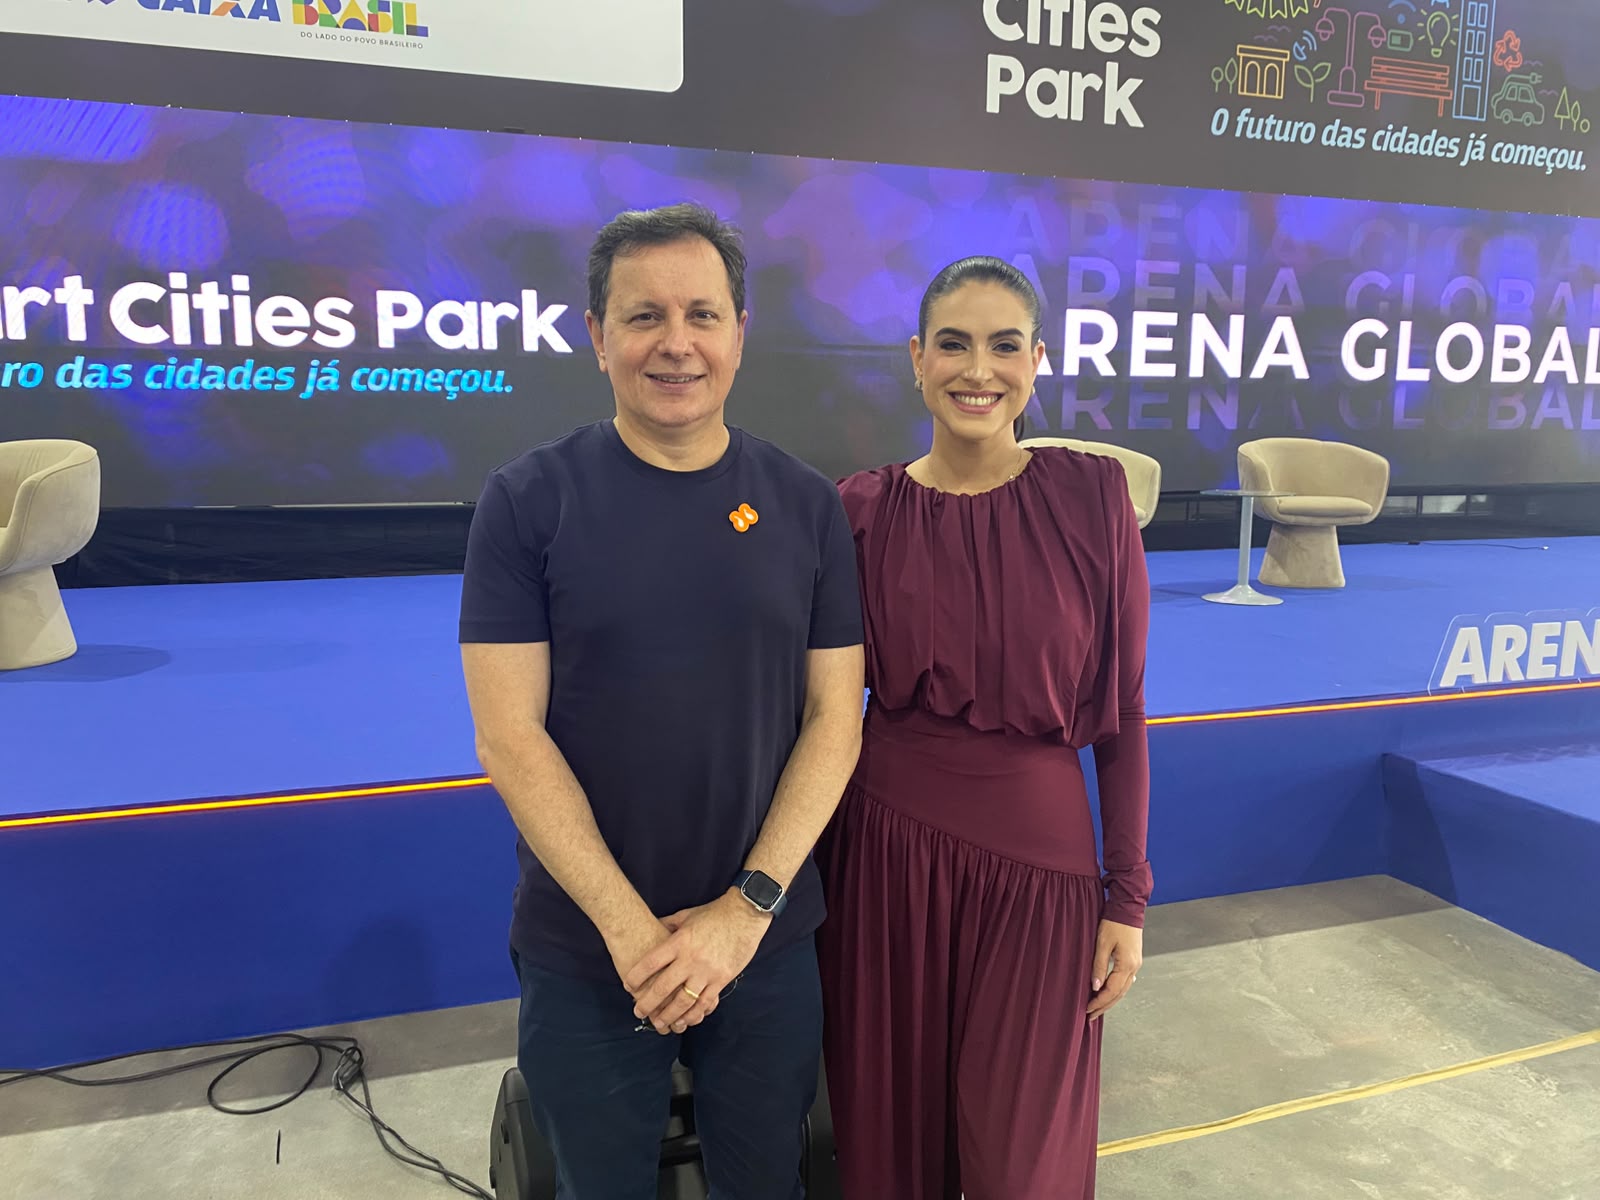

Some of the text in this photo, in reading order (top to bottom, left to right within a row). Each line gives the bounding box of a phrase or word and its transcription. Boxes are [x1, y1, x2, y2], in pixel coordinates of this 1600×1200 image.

[292, 0, 429, 37] BRASIL
[300, 31, 313, 39] DO
[315, 33, 337, 41] LADO
[354, 36, 377, 45] POVO
[379, 39, 424, 50] BRASILEIRO
[983, 0, 1162, 58] Cities
[986, 53, 1145, 128] Park
[1210, 107, 1587, 175] O futuro das cidades já começou.
[0, 271, 573, 353] rt Cities Park
[1036, 308, 1310, 379] RENA
[55, 355, 133, 389] das
[144, 357, 295, 391] cidades
[299, 359, 340, 400] já
[350, 366, 513, 400] começou.
[1439, 619, 1600, 688] AREN
